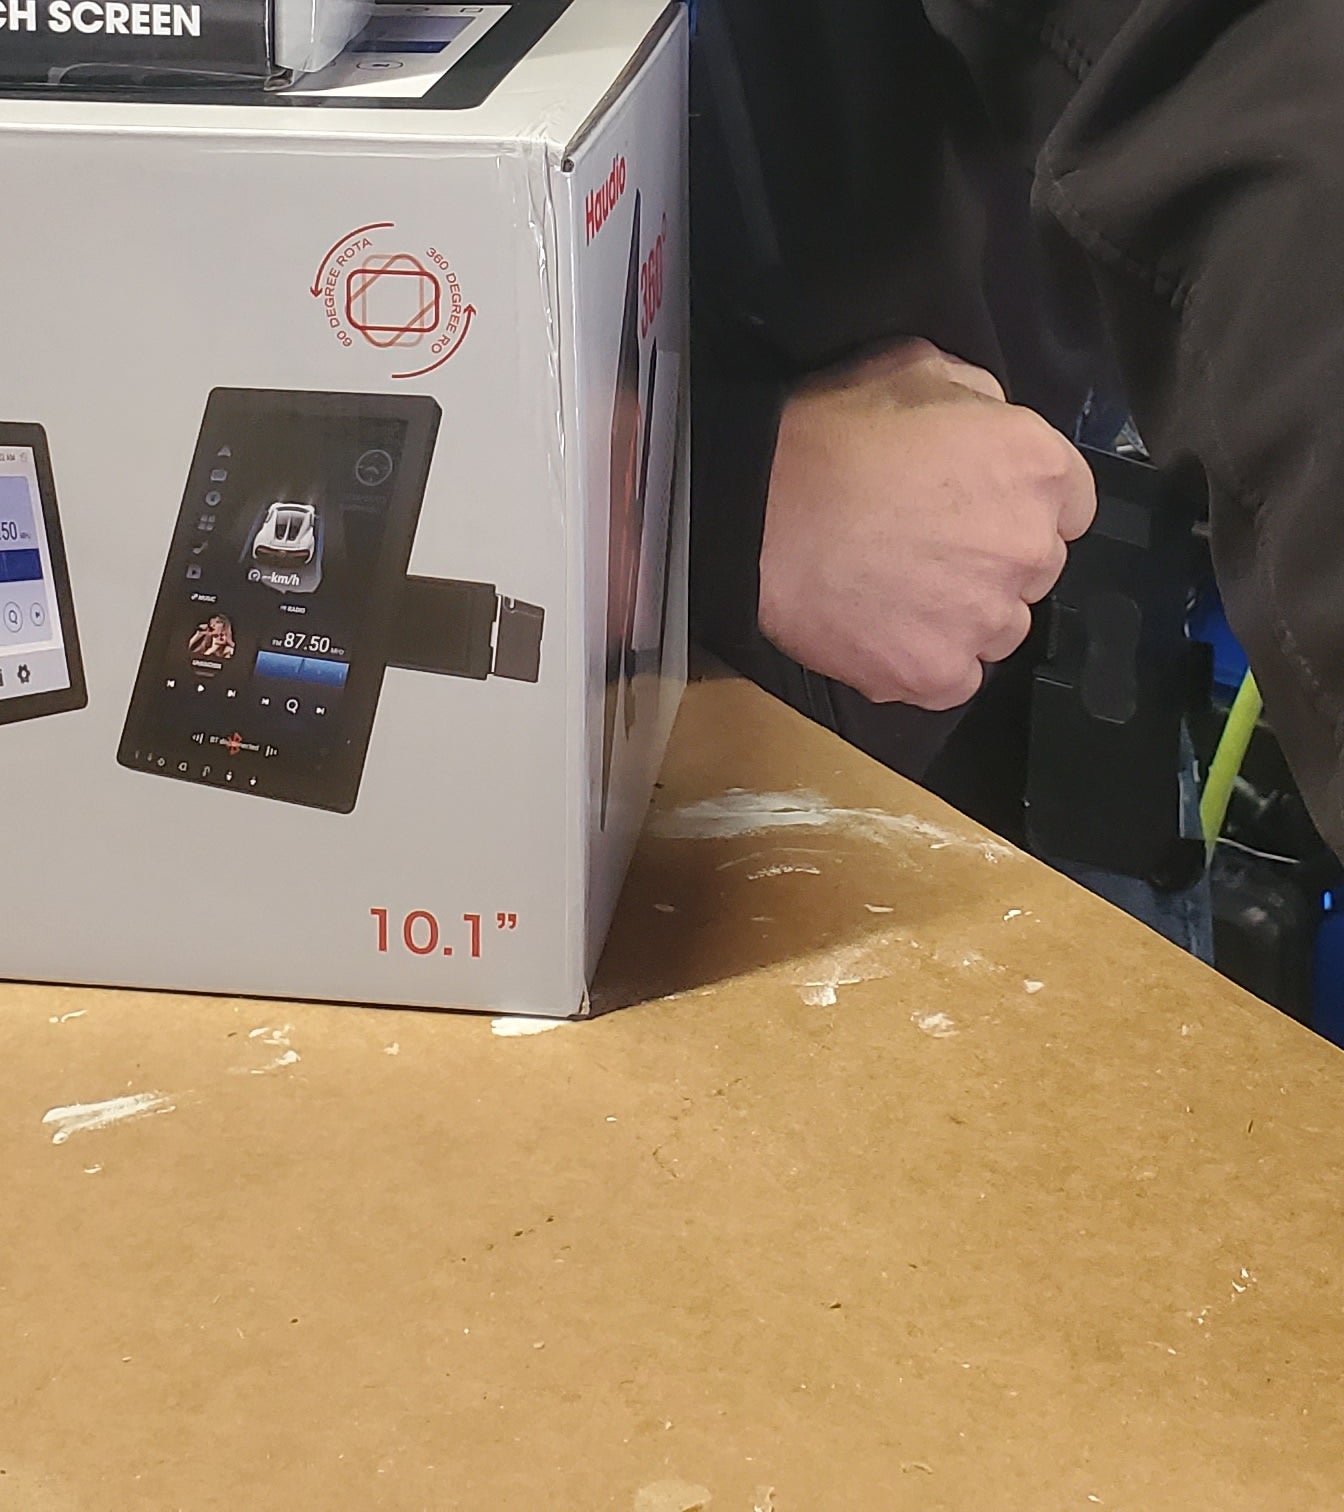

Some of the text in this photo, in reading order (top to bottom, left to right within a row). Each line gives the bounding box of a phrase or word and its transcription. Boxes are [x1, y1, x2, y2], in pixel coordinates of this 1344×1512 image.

[47, 0, 203, 38] SCREEN
[584, 152, 626, 247] Haudio
[324, 267, 341, 328] DEGREE
[335, 237, 374, 268] ROTA
[425, 246, 462, 355] 360 DEGREE RO
[283, 632, 331, 655] 87.50
